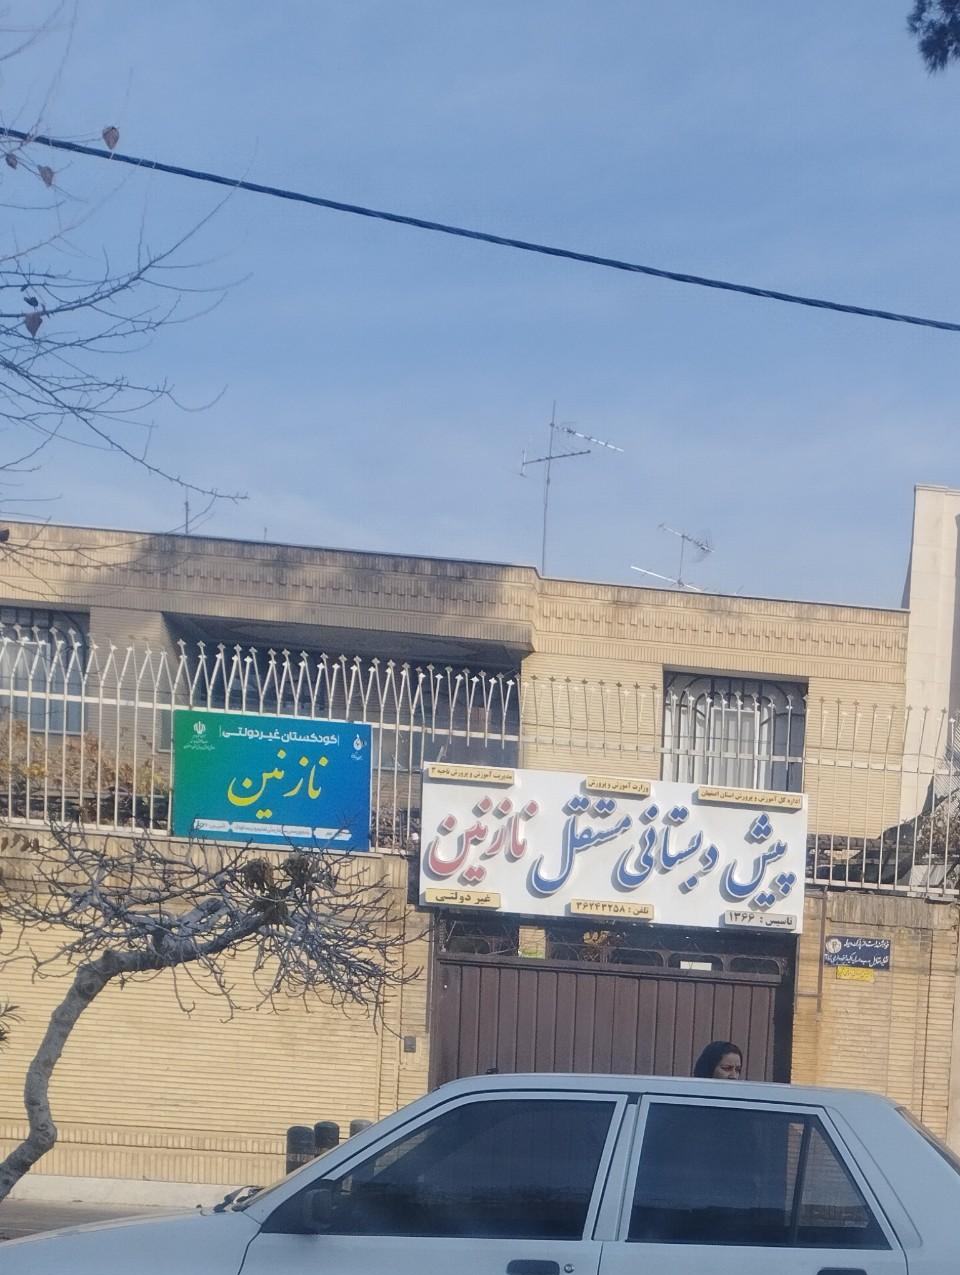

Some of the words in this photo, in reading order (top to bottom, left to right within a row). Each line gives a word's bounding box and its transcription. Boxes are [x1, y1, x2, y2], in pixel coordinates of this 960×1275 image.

[281, 728, 338, 746] کودکستان
[450, 769, 469, 778] پرورش
[474, 770, 492, 780] آموزش
[227, 749, 329, 820] نازنین
[588, 779, 607, 788] پرورش
[612, 780, 631, 790] آموزش
[632, 784, 649, 793] وزارت
[428, 796, 540, 883] نازنین
[531, 795, 633, 894] مستقل
[617, 804, 720, 889] دبستانی
[726, 813, 797, 907] پیش
[435, 891, 472, 903] دولتی
[474, 893, 491, 905] غیر
[729, 911, 755, 922] ۱۳۶۶
